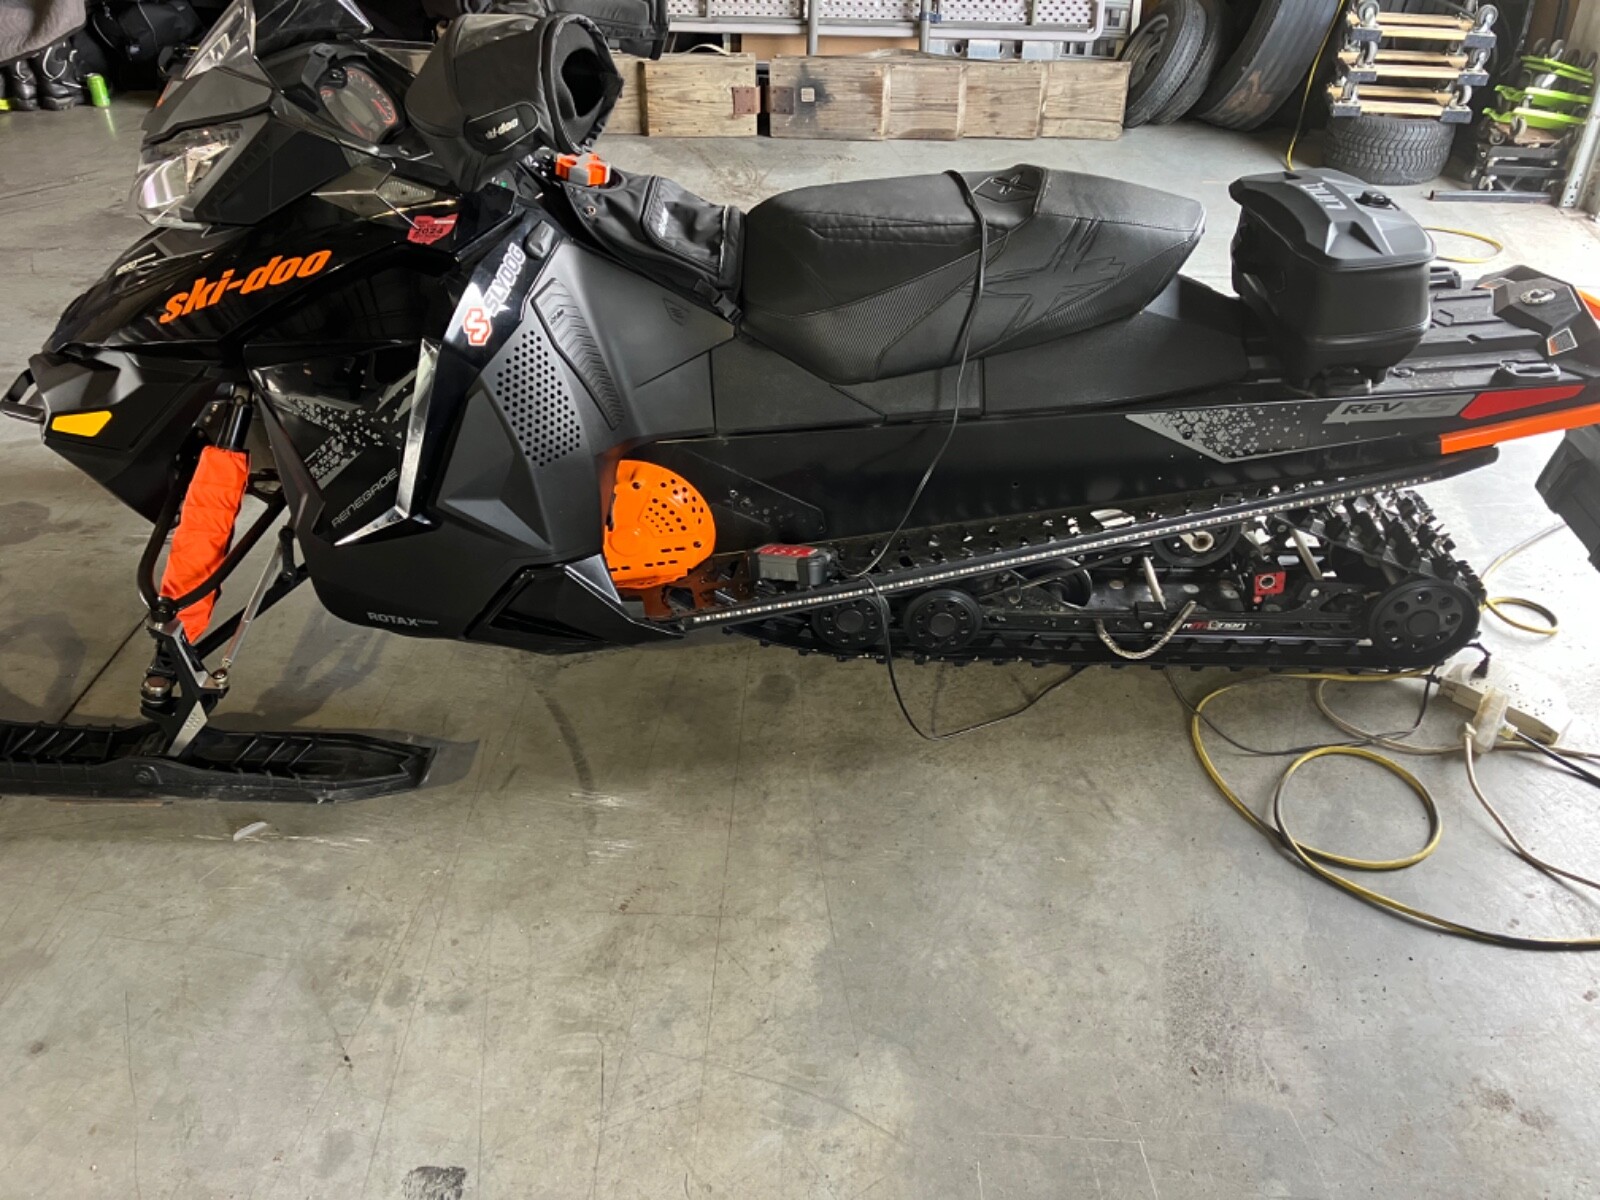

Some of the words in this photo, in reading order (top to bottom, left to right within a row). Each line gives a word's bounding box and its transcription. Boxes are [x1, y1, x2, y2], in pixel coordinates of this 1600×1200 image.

[159, 250, 332, 324] ski-doo
[331, 467, 398, 528] RENEGADE
[367, 612, 419, 627] ROTAX
